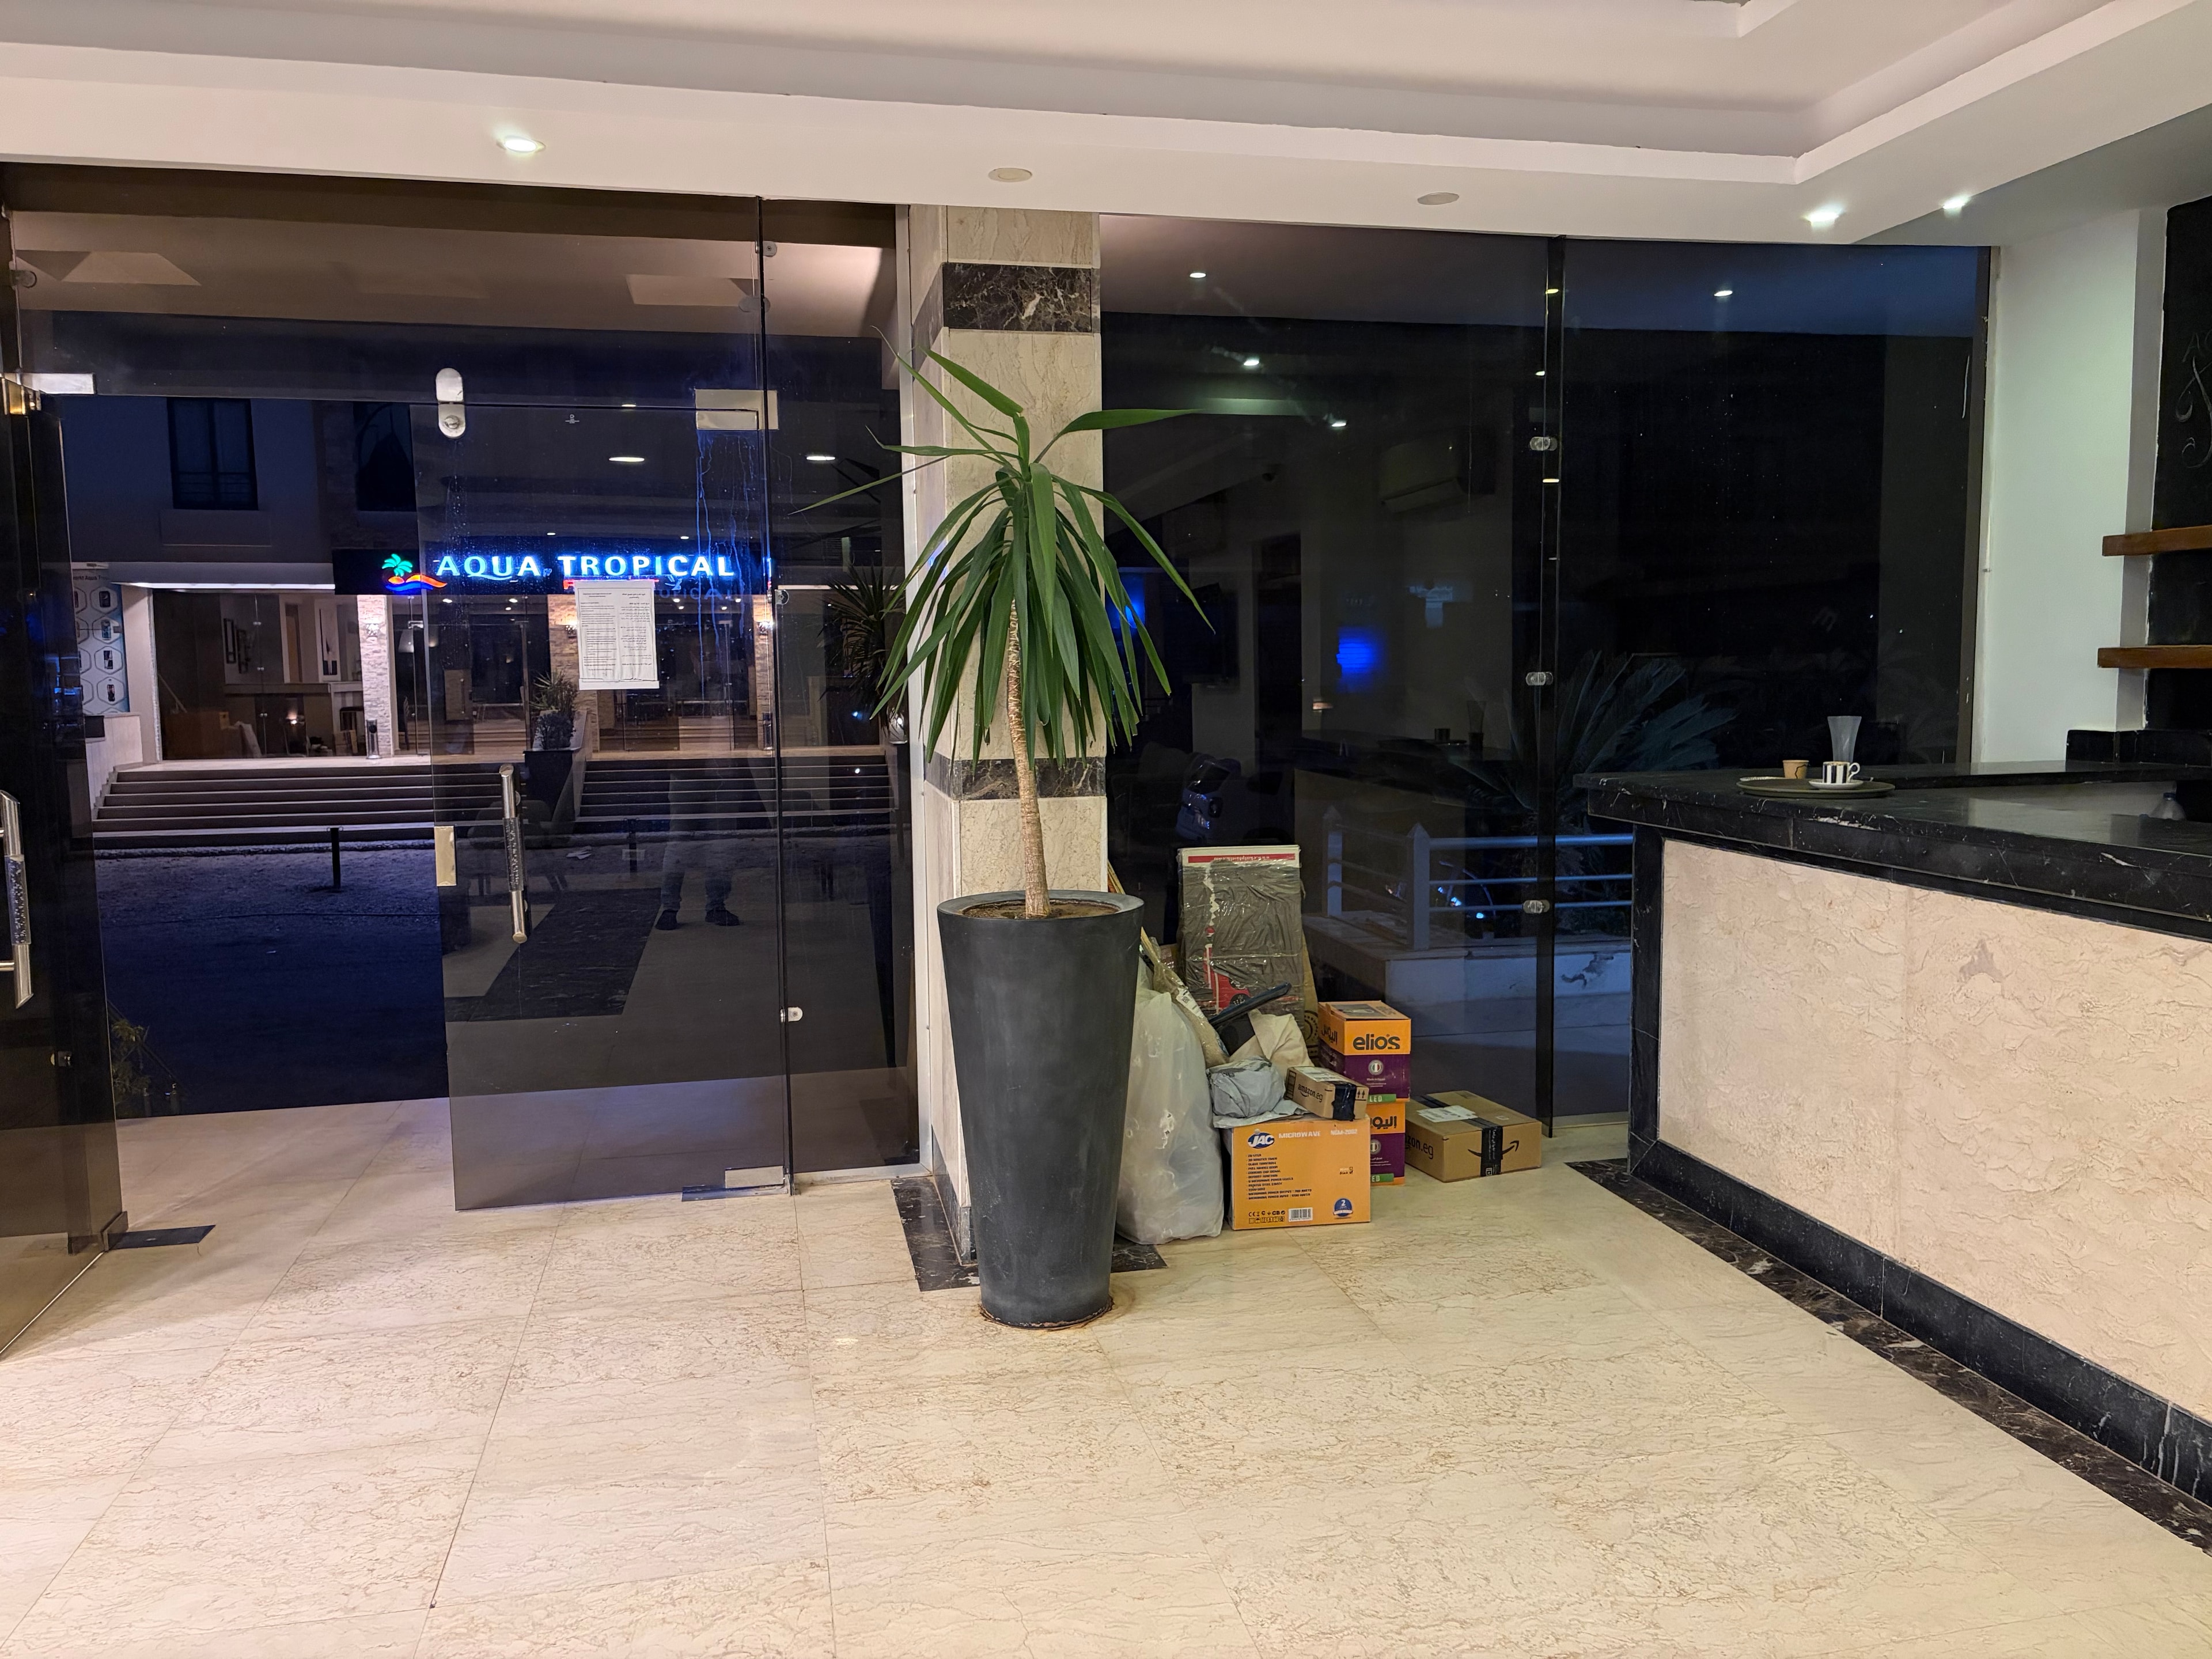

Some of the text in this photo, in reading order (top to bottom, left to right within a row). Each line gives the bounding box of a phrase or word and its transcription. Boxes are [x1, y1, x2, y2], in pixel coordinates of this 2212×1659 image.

[436, 556, 734, 580] AQUA TROPICAL
[1298, 1084, 1323, 1103] amazon.eg
[1248, 1135, 1274, 1147] JAC
[1406, 1133, 1434, 1160] zon.eg
